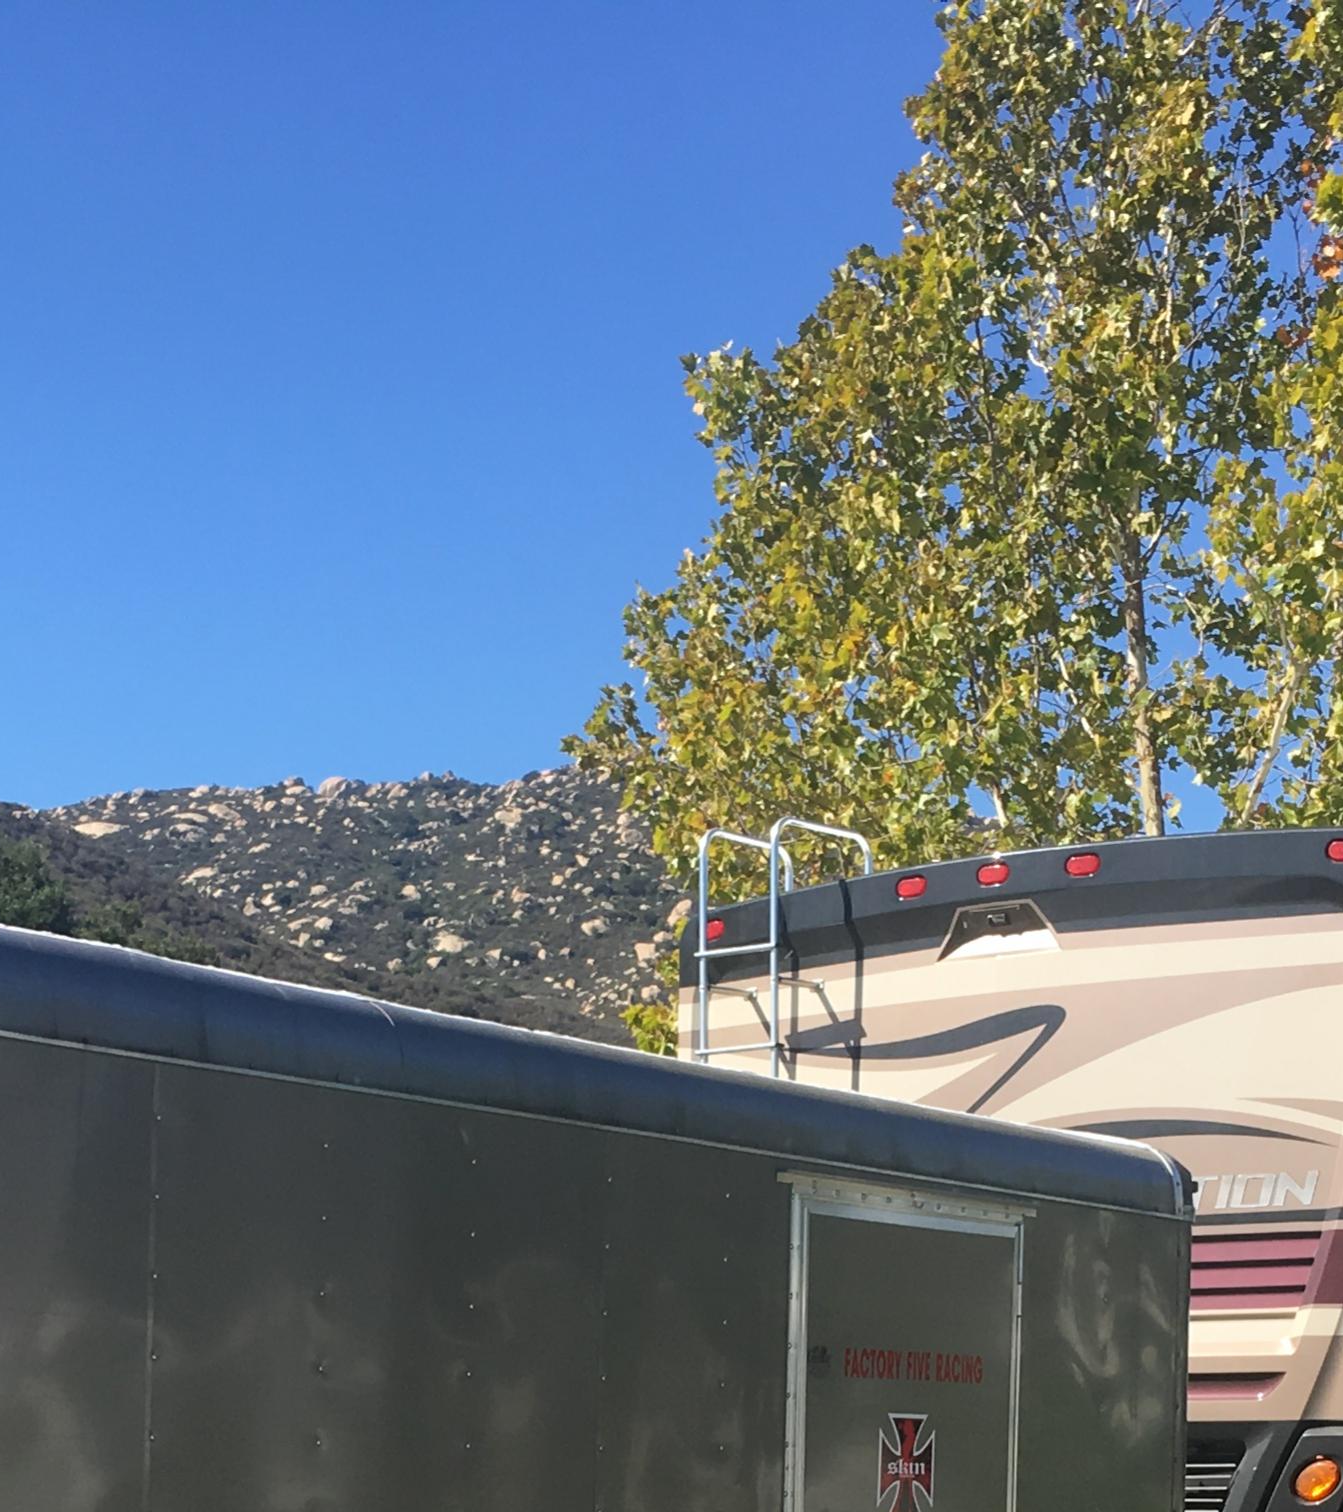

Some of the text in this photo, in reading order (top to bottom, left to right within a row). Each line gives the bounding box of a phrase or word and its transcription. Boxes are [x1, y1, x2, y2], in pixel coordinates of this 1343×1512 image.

[844, 1348, 983, 1384] FACTORY FIVE RACING
